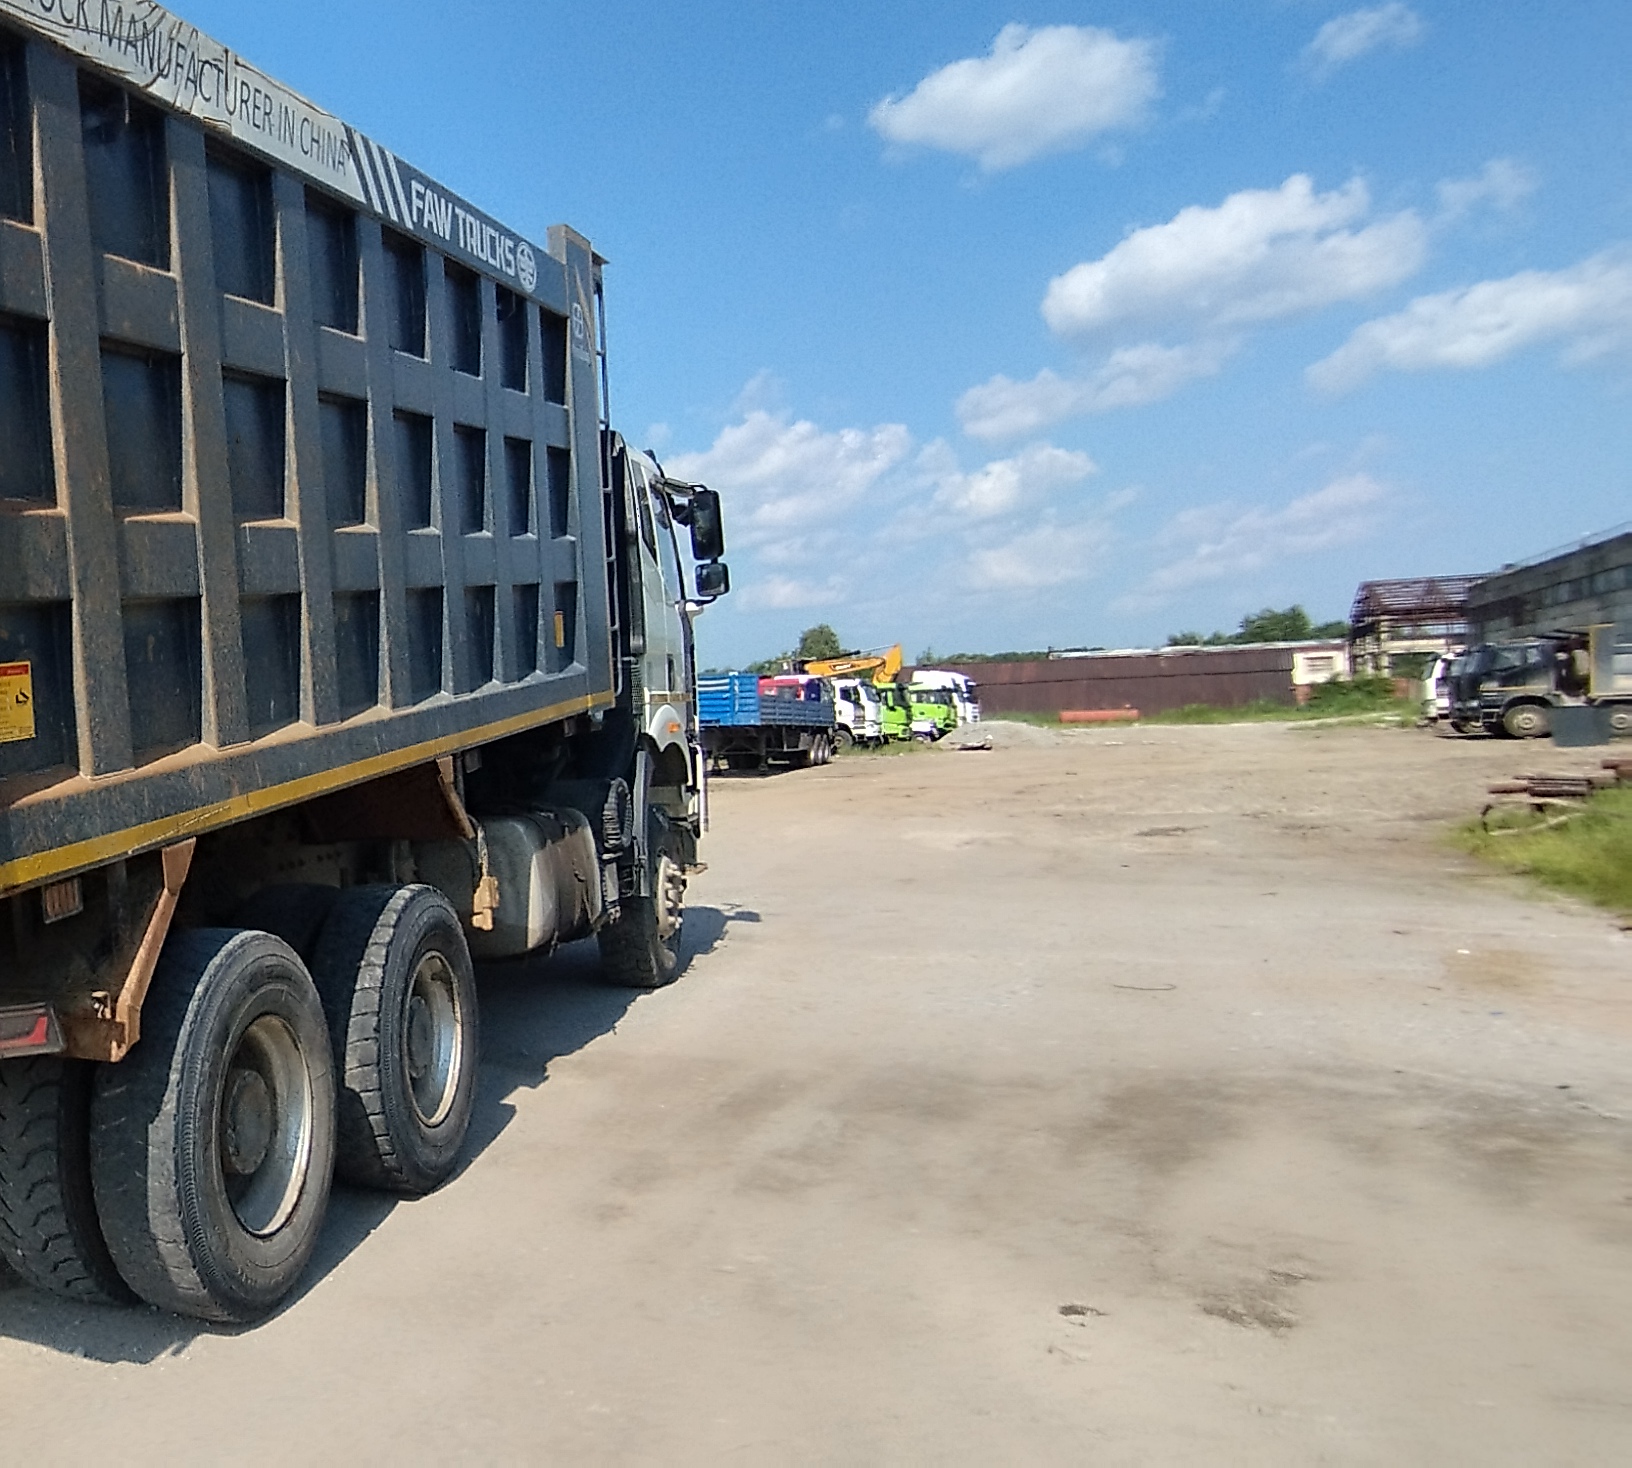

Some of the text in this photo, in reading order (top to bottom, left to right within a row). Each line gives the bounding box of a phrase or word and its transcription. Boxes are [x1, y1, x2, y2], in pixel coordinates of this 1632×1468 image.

[100, 0, 273, 137] MANUFACTURER
[278, 102, 296, 148] IN
[300, 117, 351, 176] CHINA
[410, 180, 516, 277] FAW TRUCKS
